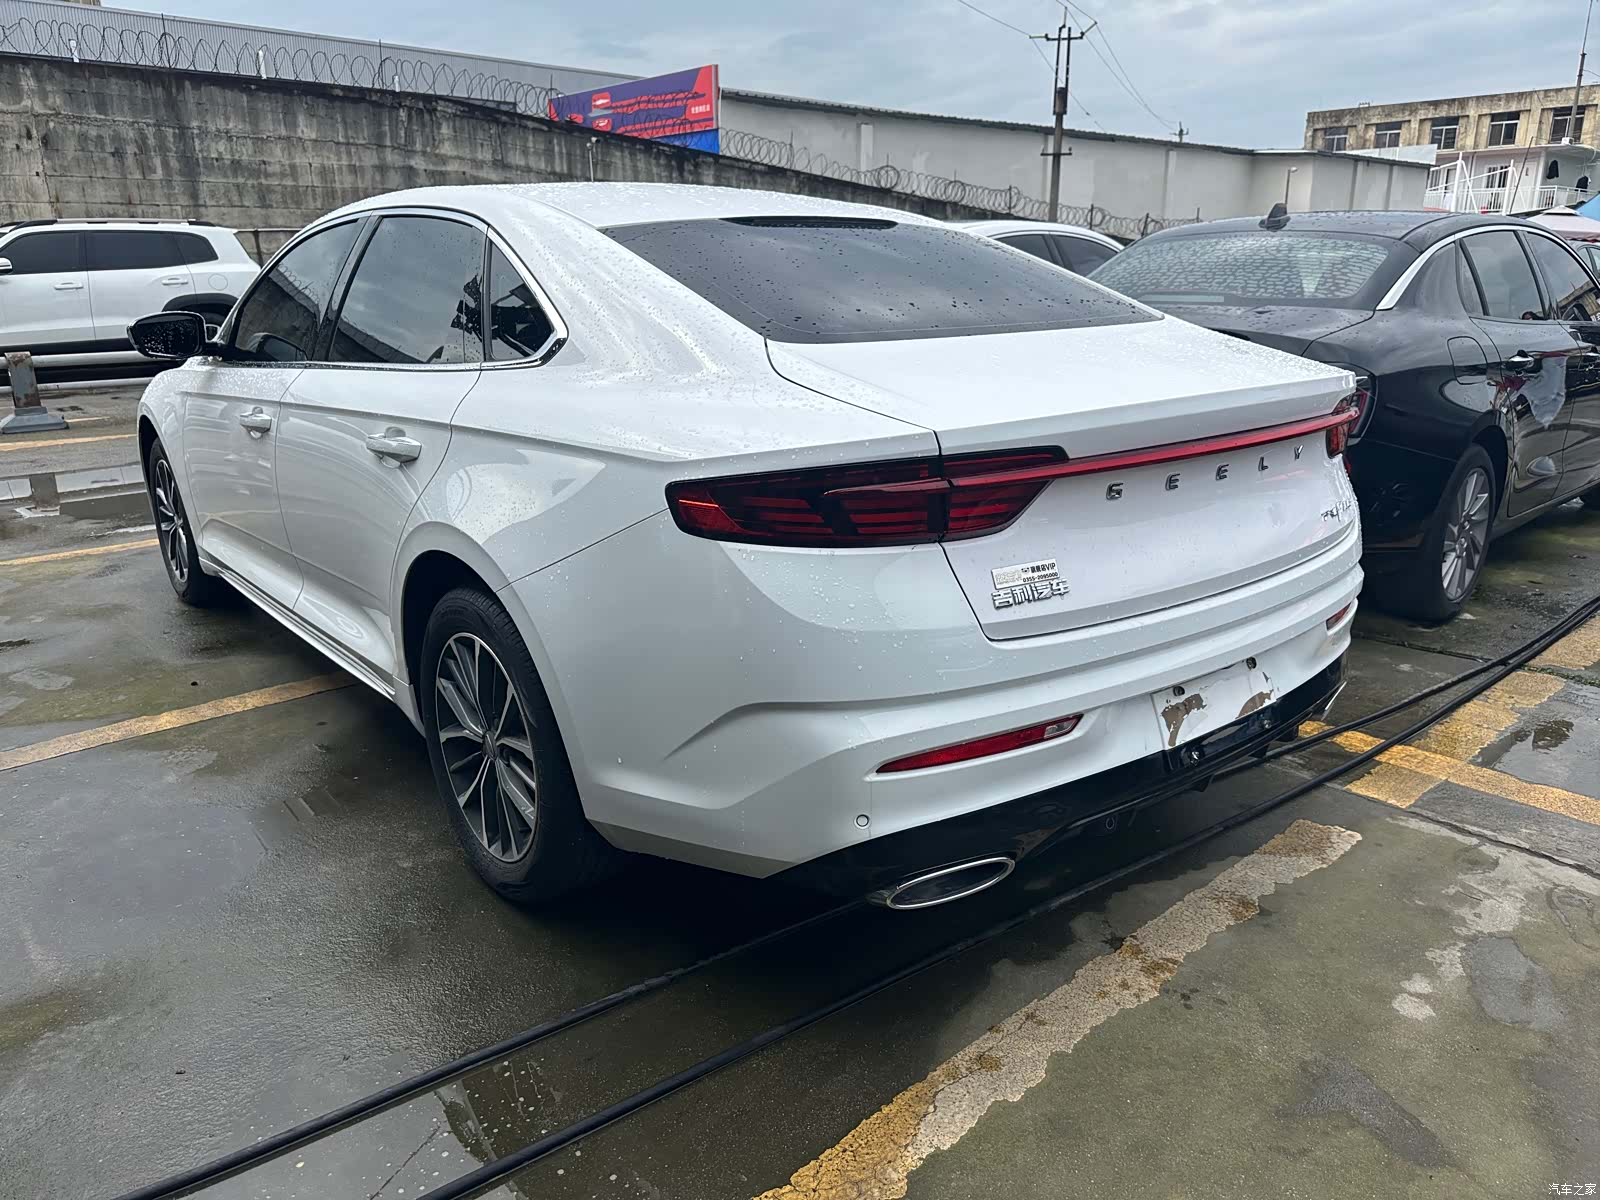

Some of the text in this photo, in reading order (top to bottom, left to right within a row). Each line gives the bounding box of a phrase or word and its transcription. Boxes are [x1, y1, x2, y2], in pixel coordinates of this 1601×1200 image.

[1105, 445, 1304, 500] GEELY
[991, 579, 1070, 610] 吉利汽车
